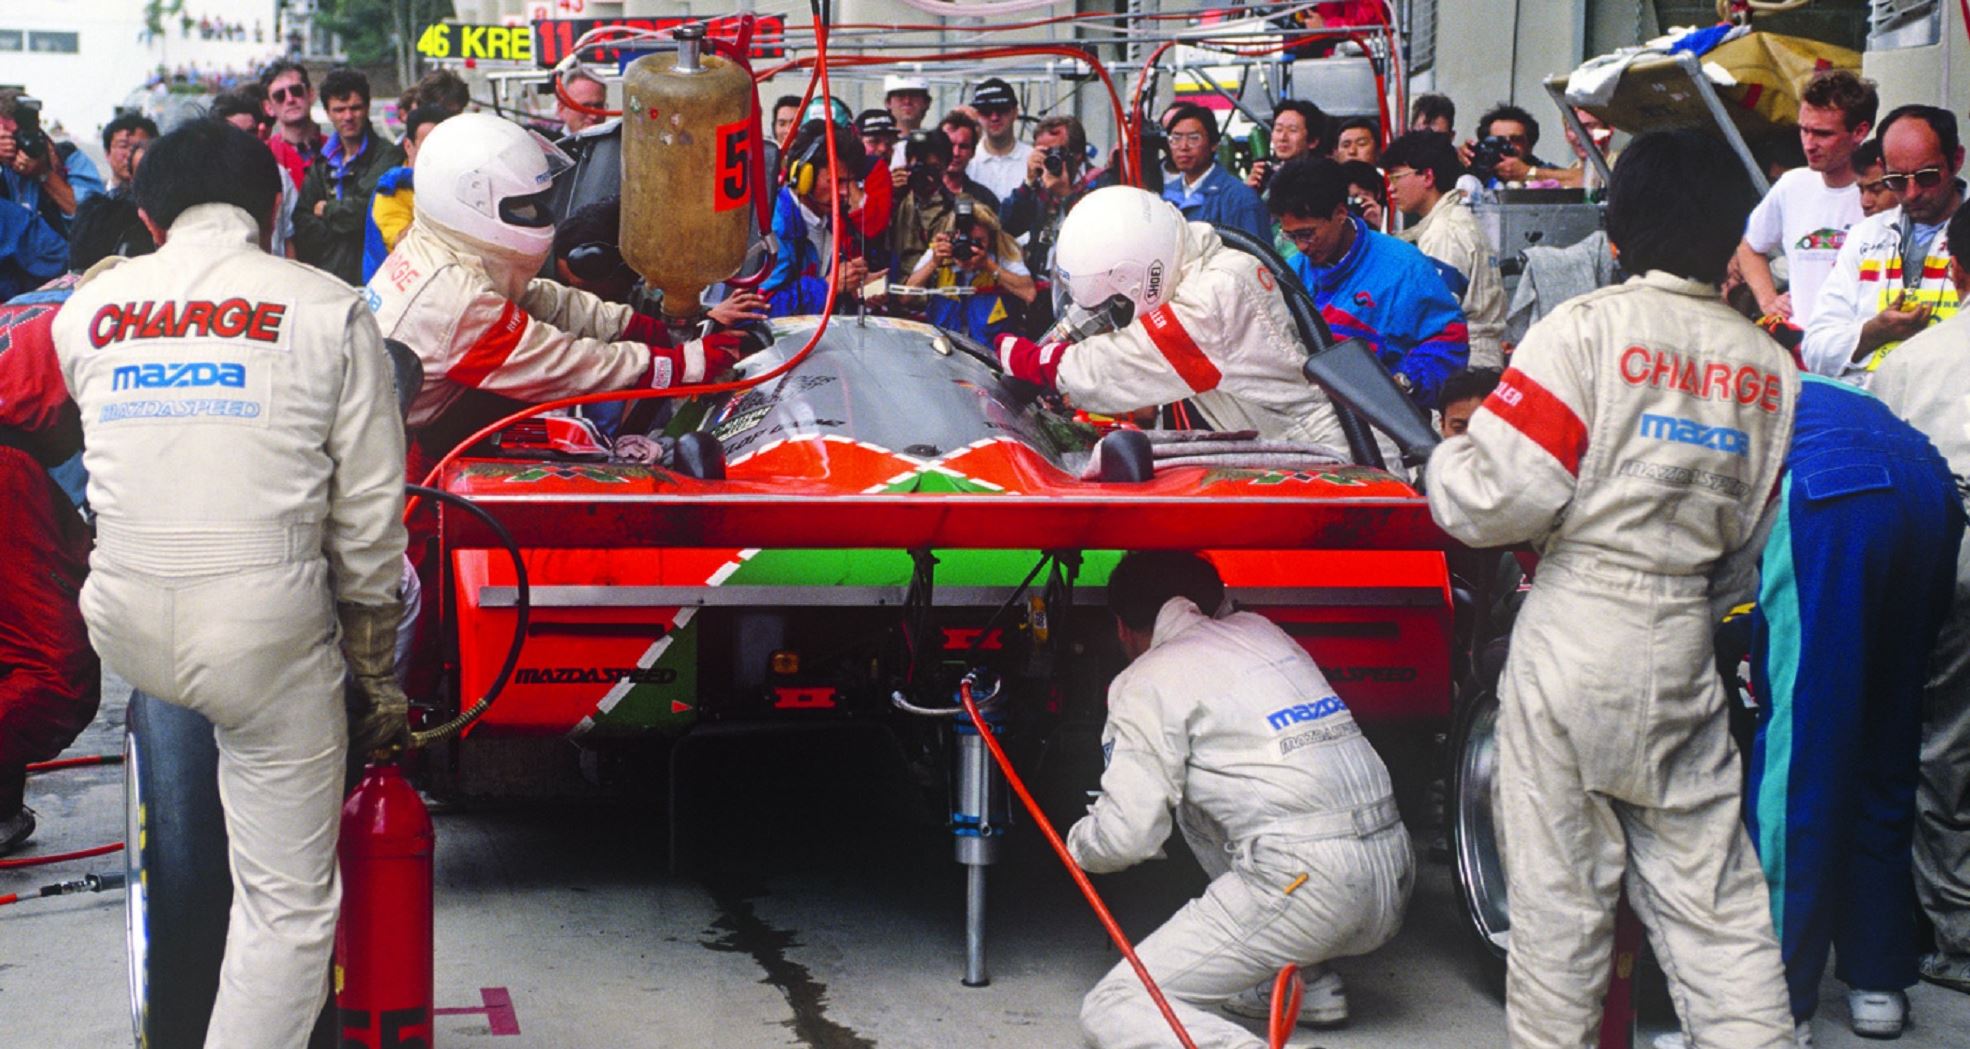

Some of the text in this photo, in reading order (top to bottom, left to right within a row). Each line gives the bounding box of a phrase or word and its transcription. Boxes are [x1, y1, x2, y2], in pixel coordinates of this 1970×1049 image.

[417, 23, 531, 60] 46 KRE
[538, 21, 574, 65] 11
[724, 131, 748, 200] 5
[1147, 266, 1162, 299] SHOEI
[88, 297, 287, 350] CHARGE
[1620, 345, 1781, 414] CHARGE
[514, 667, 678, 684] MAZDASPEED
